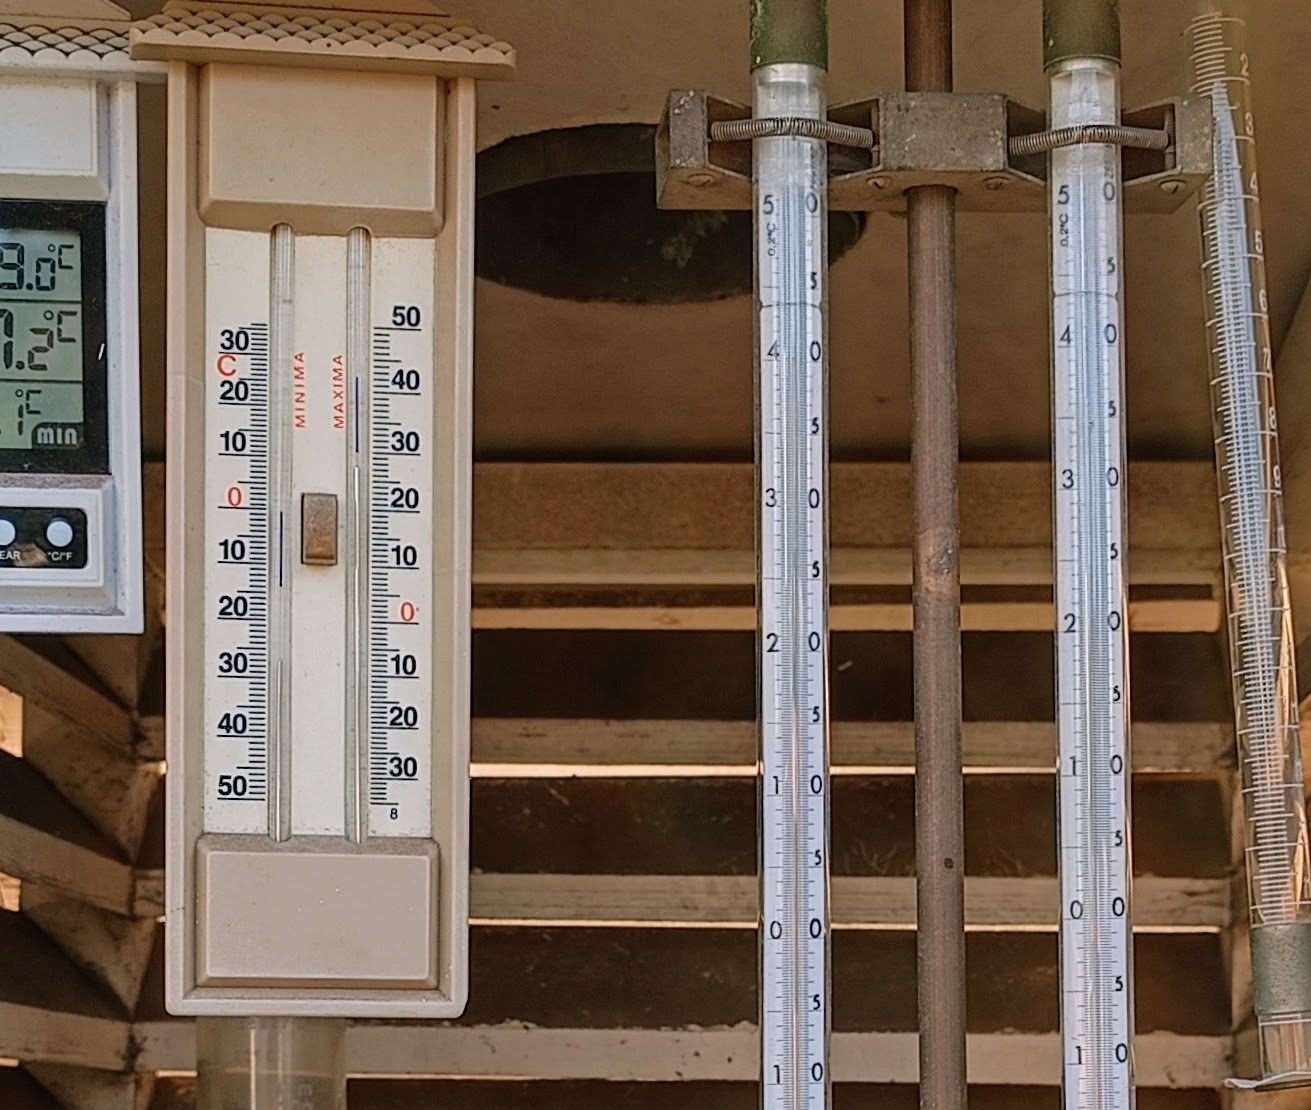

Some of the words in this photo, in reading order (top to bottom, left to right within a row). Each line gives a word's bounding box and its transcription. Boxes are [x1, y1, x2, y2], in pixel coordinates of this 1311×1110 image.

[391, 306, 420, 327] 50
[220, 330, 249, 350] 30
[216, 354, 237, 376] C
[294, 352, 306, 428] MINIMA
[391, 370, 420, 390] 40
[219, 380, 249, 401] 20
[332, 354, 345, 429] MAXIMA
[219, 431, 246, 452] 10
[391, 431, 419, 452] 30
[227, 487, 242, 506] 0
[390, 488, 419, 508] 20
[219, 539, 246, 560] 10
[391, 546, 417, 566] 10
[218, 596, 248, 617] 20
[400, 602, 415, 621] 0
[218, 653, 248, 673] 30
[390, 655, 417, 675] 10
[217, 713, 248, 734] 40
[389, 707, 418, 727] 20
[389, 757, 418, 777] 30
[217, 775, 248, 796] 50
[390, 808, 398, 820] 8
